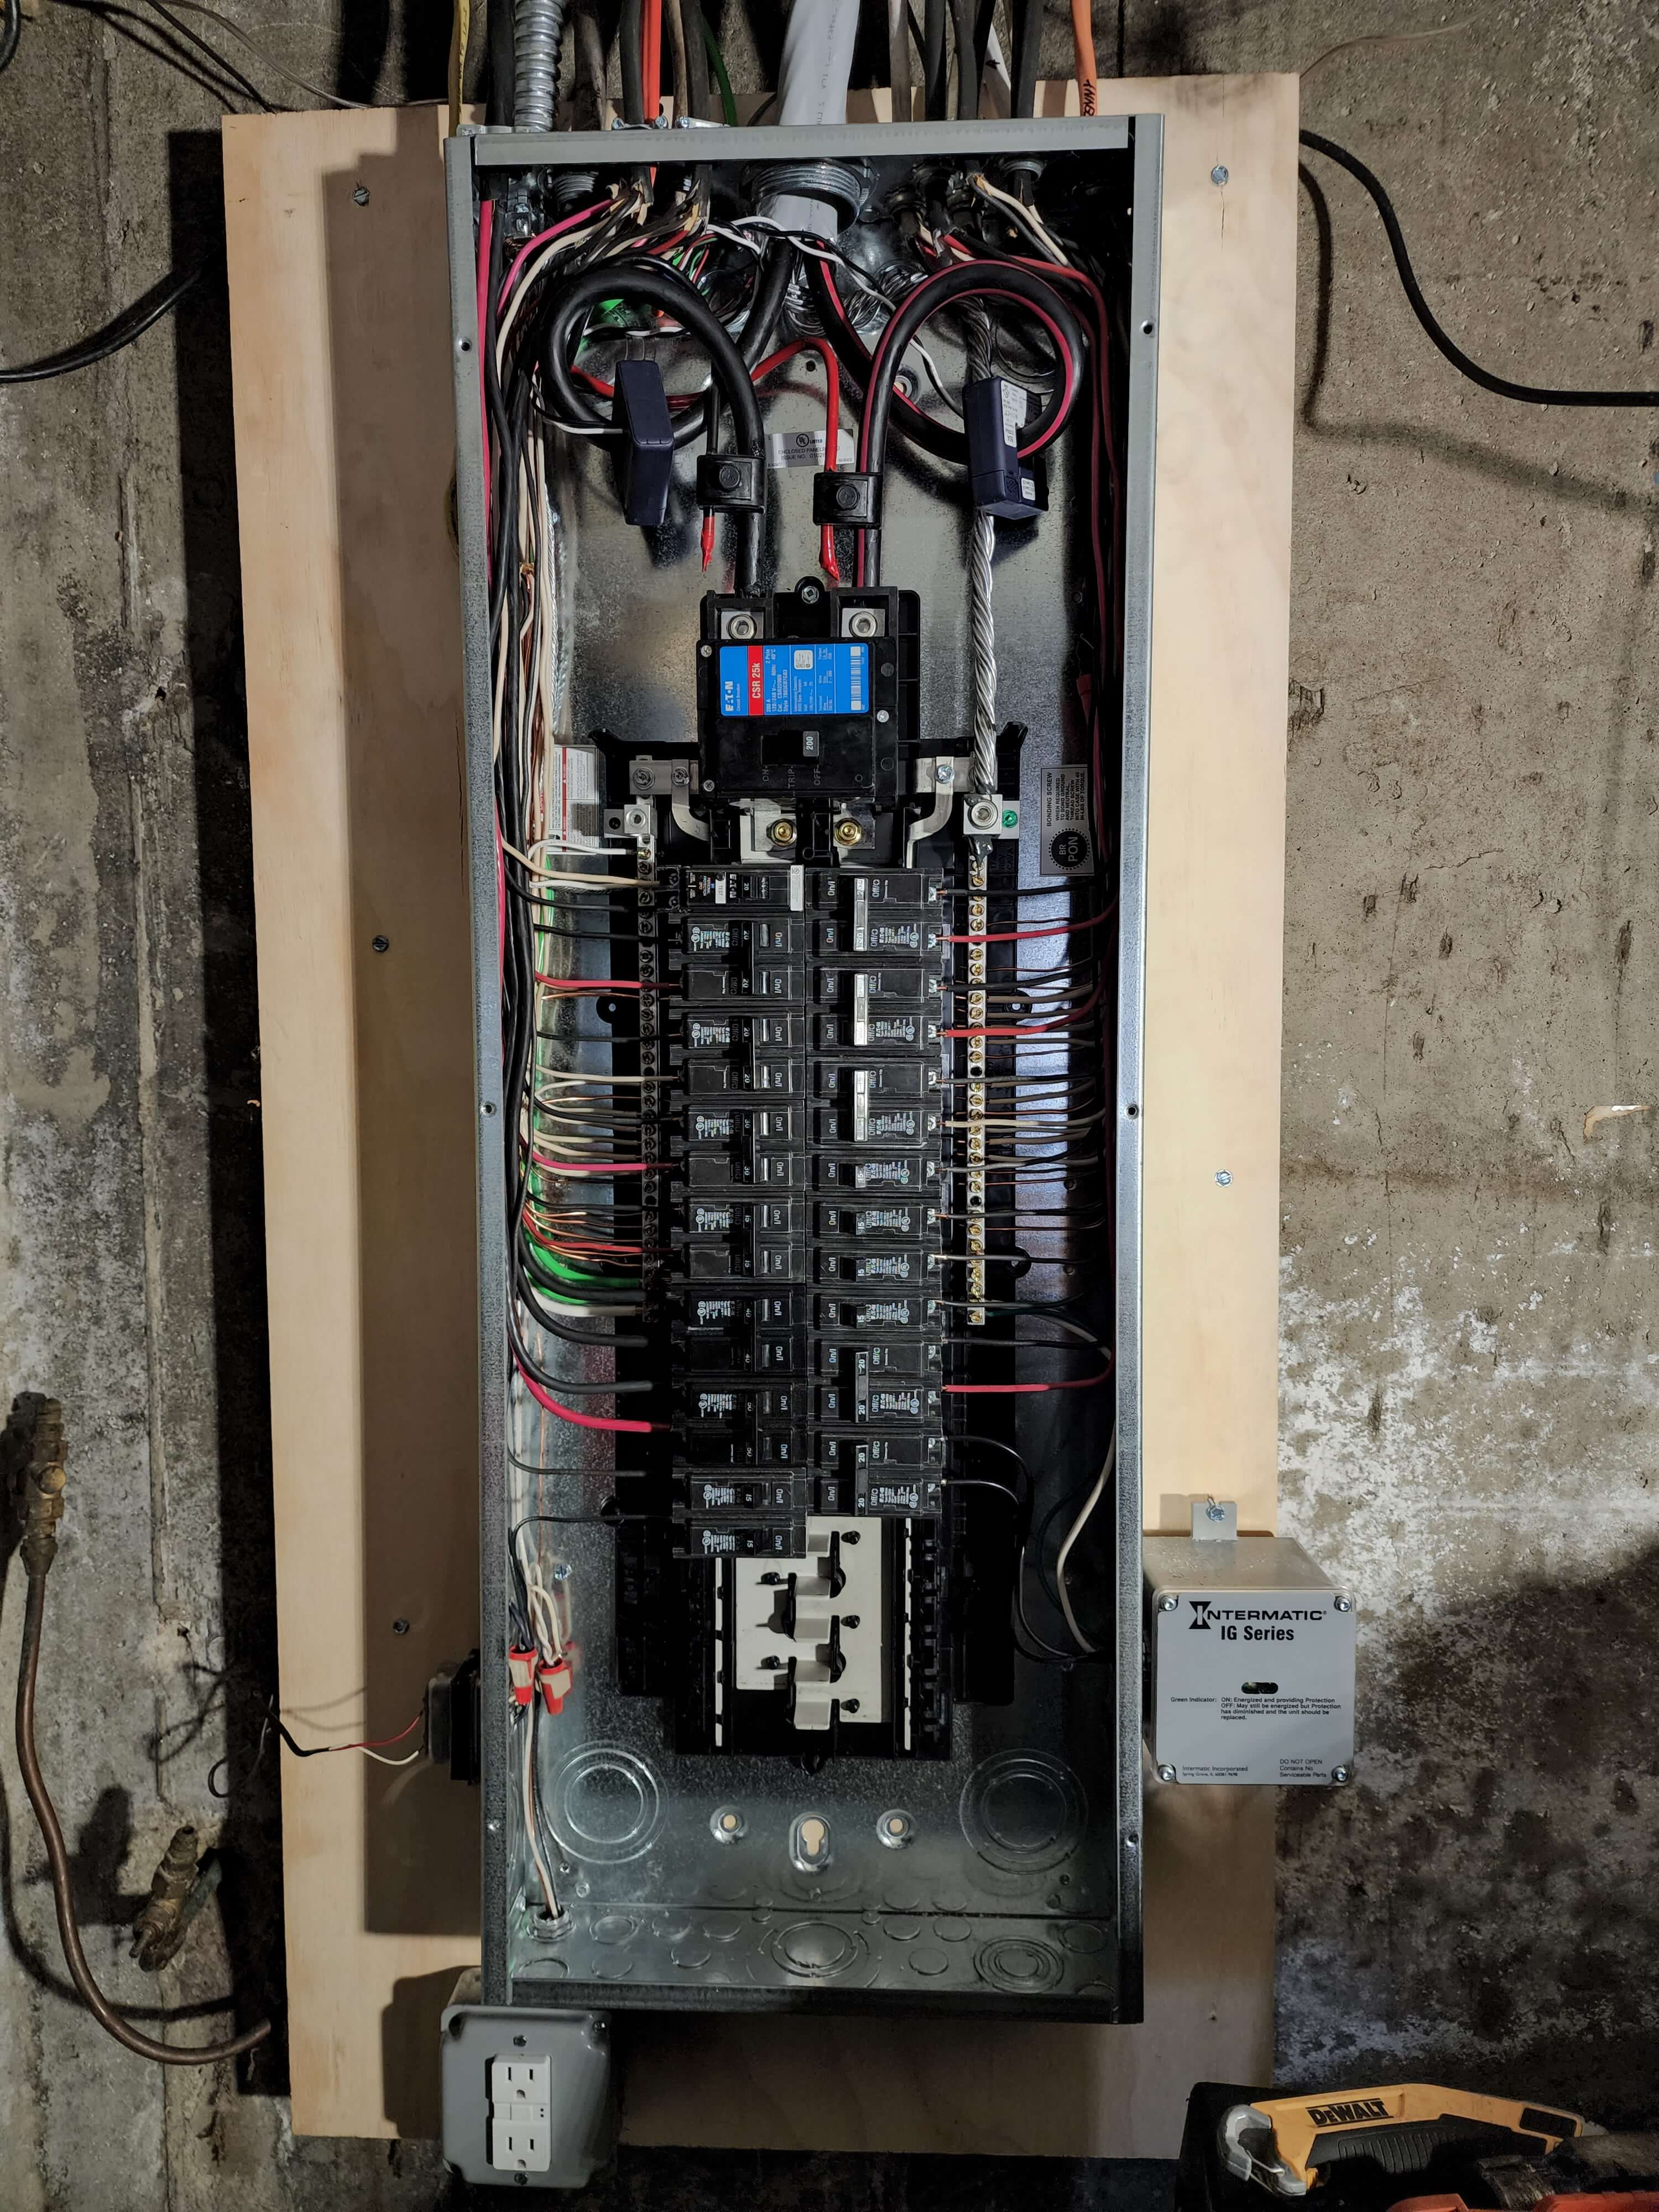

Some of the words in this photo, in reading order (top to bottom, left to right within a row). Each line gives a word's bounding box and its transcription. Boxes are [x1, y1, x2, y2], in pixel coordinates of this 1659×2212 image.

[752, 663, 761, 679] 25k
[752, 681, 761, 699] CSR
[806, 736, 814, 750] 200
[762, 769, 769, 782] ON
[1059, 844, 1066, 855] BR
[1068, 836, 1078, 862] PON
[744, 883, 749, 891] 20
[743, 930, 749, 940] 20
[743, 978, 749, 988] 20
[744, 1027, 750, 1037] 20
[744, 1073, 751, 1084] 20
[744, 1119, 751, 1129] 30
[744, 1166, 750, 1176] 30
[745, 1214, 752, 1223] 15
[745, 1353, 752, 1363] 40
[858, 1359, 865, 1369] 20
[858, 1405, 865, 1415] 20
[858, 1453, 865, 1463] 20
[745, 1494, 752, 1502] 15
[858, 1498, 865, 1508] 20
[747, 1540, 753, 1548] 15
[1188, 1601, 1323, 1630] INTERMATIC
[1221, 1625, 1237, 1641] IG
[1243, 1625, 1295, 1641] Series
